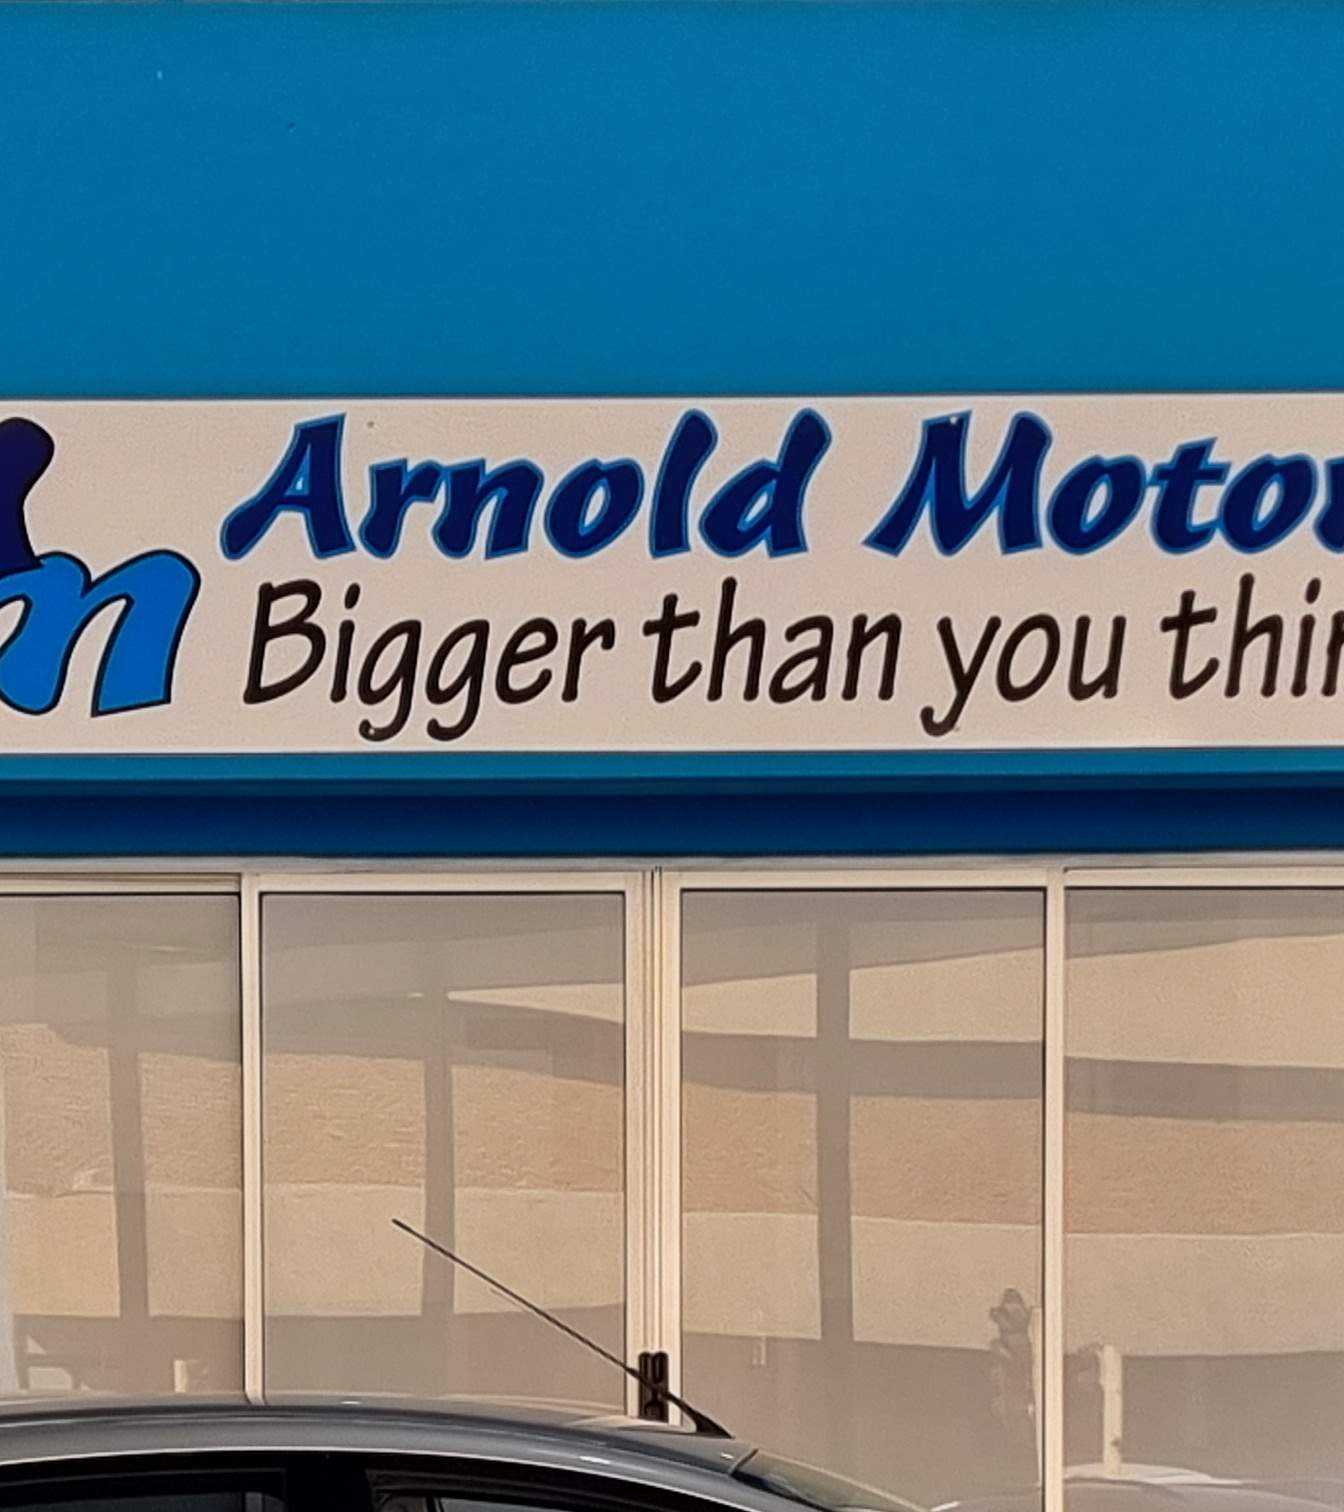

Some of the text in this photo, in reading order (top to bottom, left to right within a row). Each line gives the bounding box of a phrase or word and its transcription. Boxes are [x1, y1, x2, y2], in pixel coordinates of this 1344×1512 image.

[219, 408, 832, 560] Arnold
[243, 578, 616, 742] Bigger
[642, 576, 902, 705] than
[920, 614, 1128, 738] you
